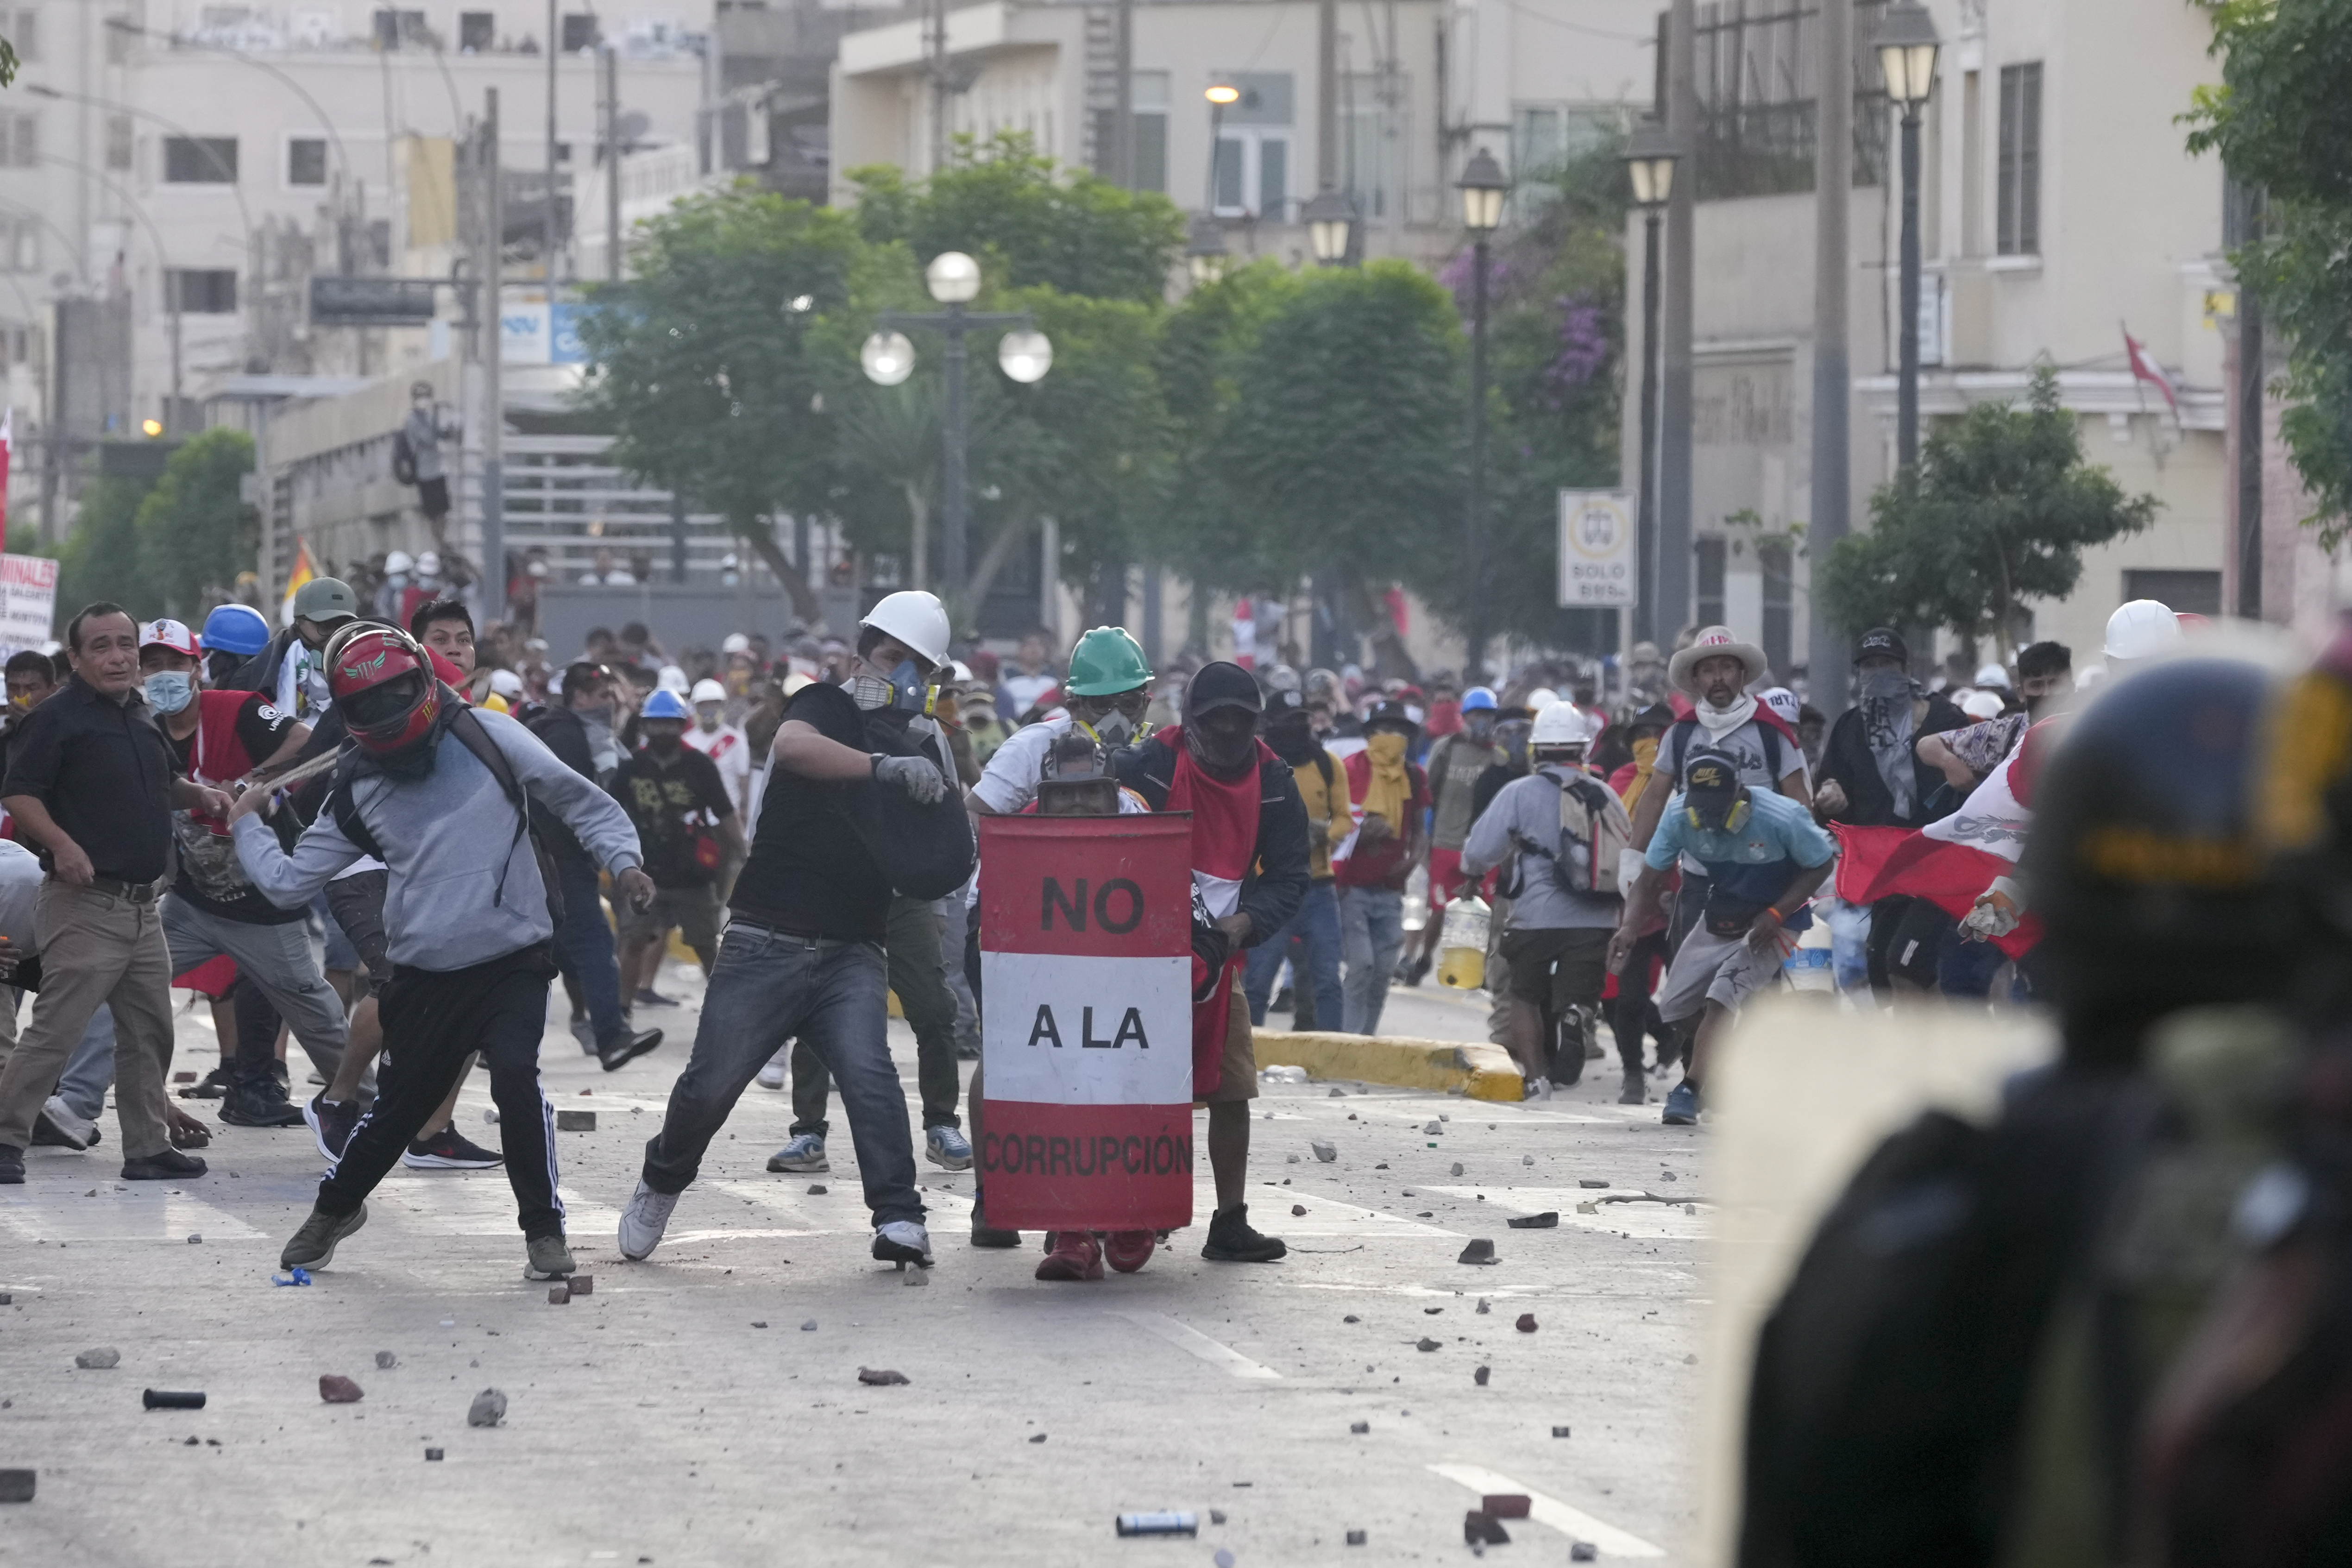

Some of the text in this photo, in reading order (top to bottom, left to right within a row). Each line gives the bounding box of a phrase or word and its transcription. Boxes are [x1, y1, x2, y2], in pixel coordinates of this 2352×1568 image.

[1573, 562, 1626, 579] SOLO
[1694, 768, 1717, 778] NIKE
[1041, 876, 1145, 934] NO
[1028, 1004, 1149, 1049] A LA
[983, 1124, 1193, 1177] CORRUPCIÓN
